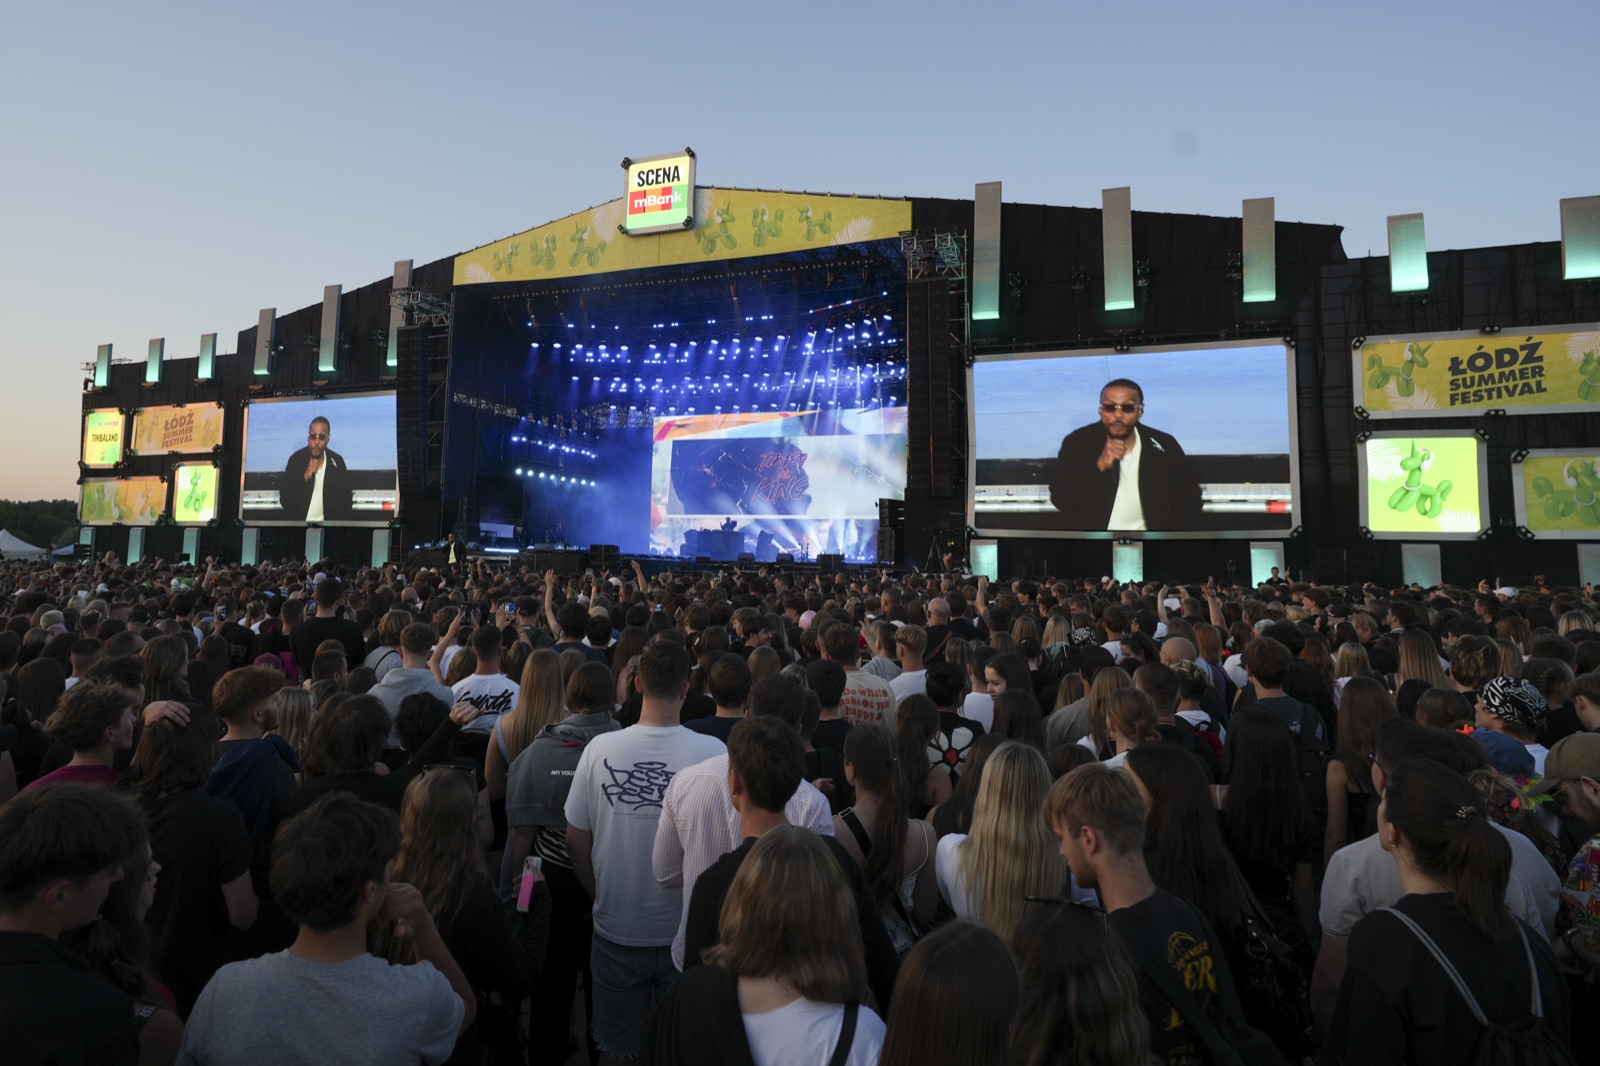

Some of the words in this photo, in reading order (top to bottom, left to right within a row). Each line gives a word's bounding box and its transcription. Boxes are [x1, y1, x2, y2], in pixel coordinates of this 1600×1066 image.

[637, 165, 680, 187] SCENA
[634, 191, 683, 208] mBank
[1448, 336, 1544, 376] ŁÓDŹ
[1449, 365, 1545, 391] SUMMER
[1449, 380, 1547, 406] FESTIVAL
[163, 409, 195, 432] ŁÓDŹ
[91, 433, 119, 442] TIMBALAND
[161, 434, 193, 449] FESTIVAL
[162, 425, 194, 441] SUMMER
[751, 476, 810, 505] KING
[858, 687, 882, 697] what
